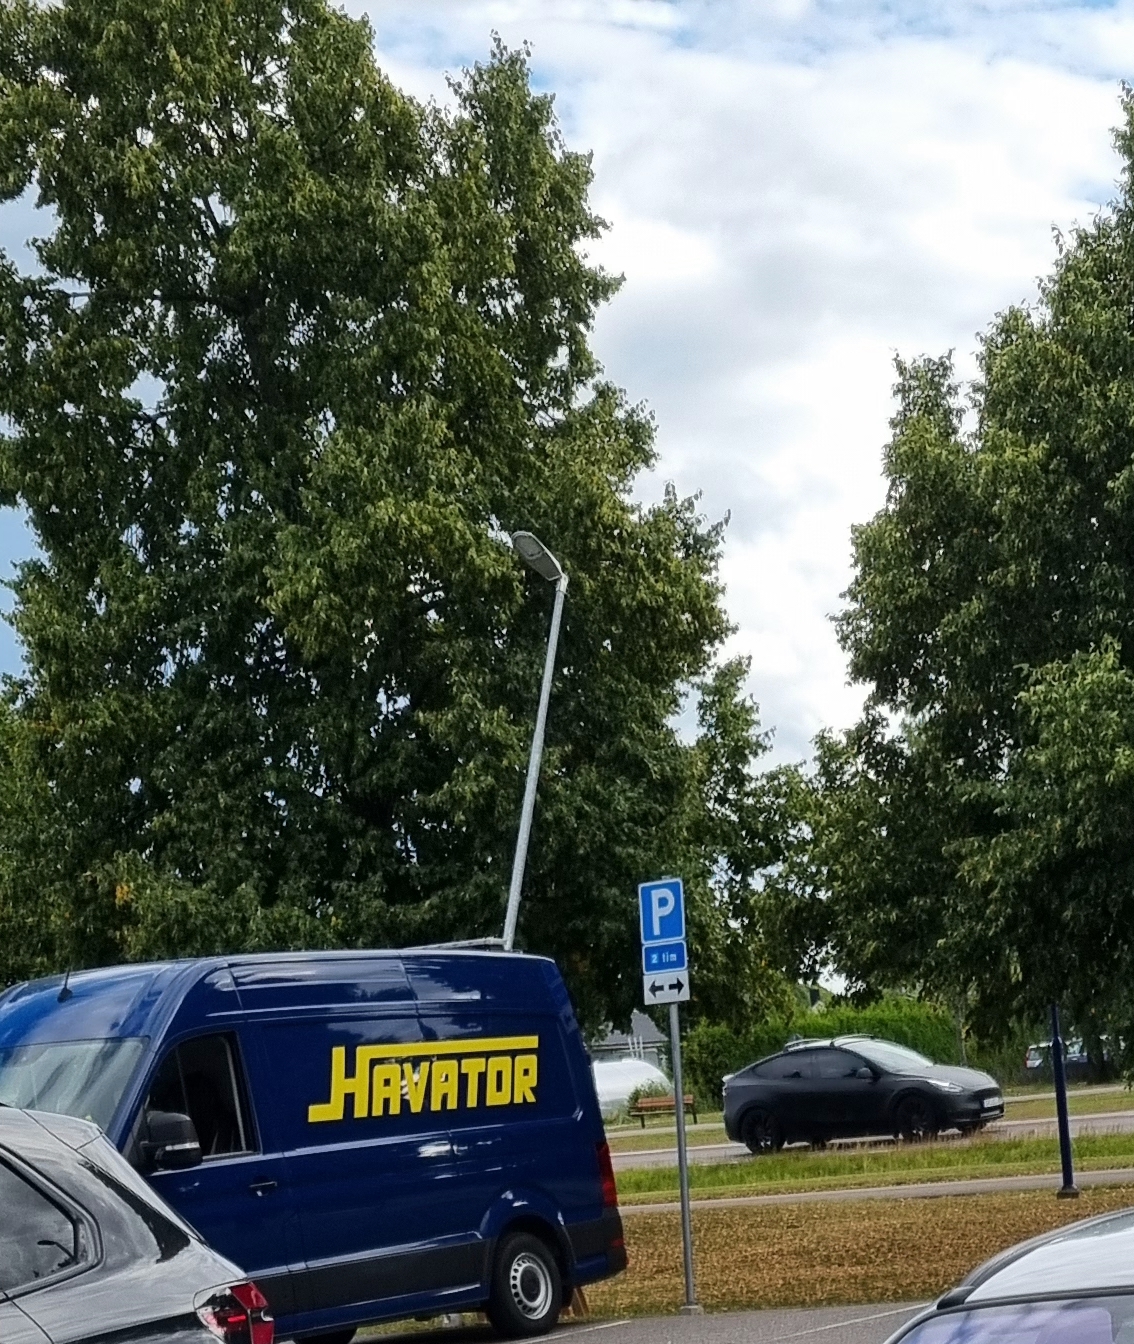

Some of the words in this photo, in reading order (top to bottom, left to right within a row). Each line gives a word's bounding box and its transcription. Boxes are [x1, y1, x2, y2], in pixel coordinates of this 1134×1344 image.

[651, 888, 675, 936] P
[651, 954, 659, 964] 2
[662, 952, 677, 963] tim
[308, 1035, 539, 1123] HAVATOR
